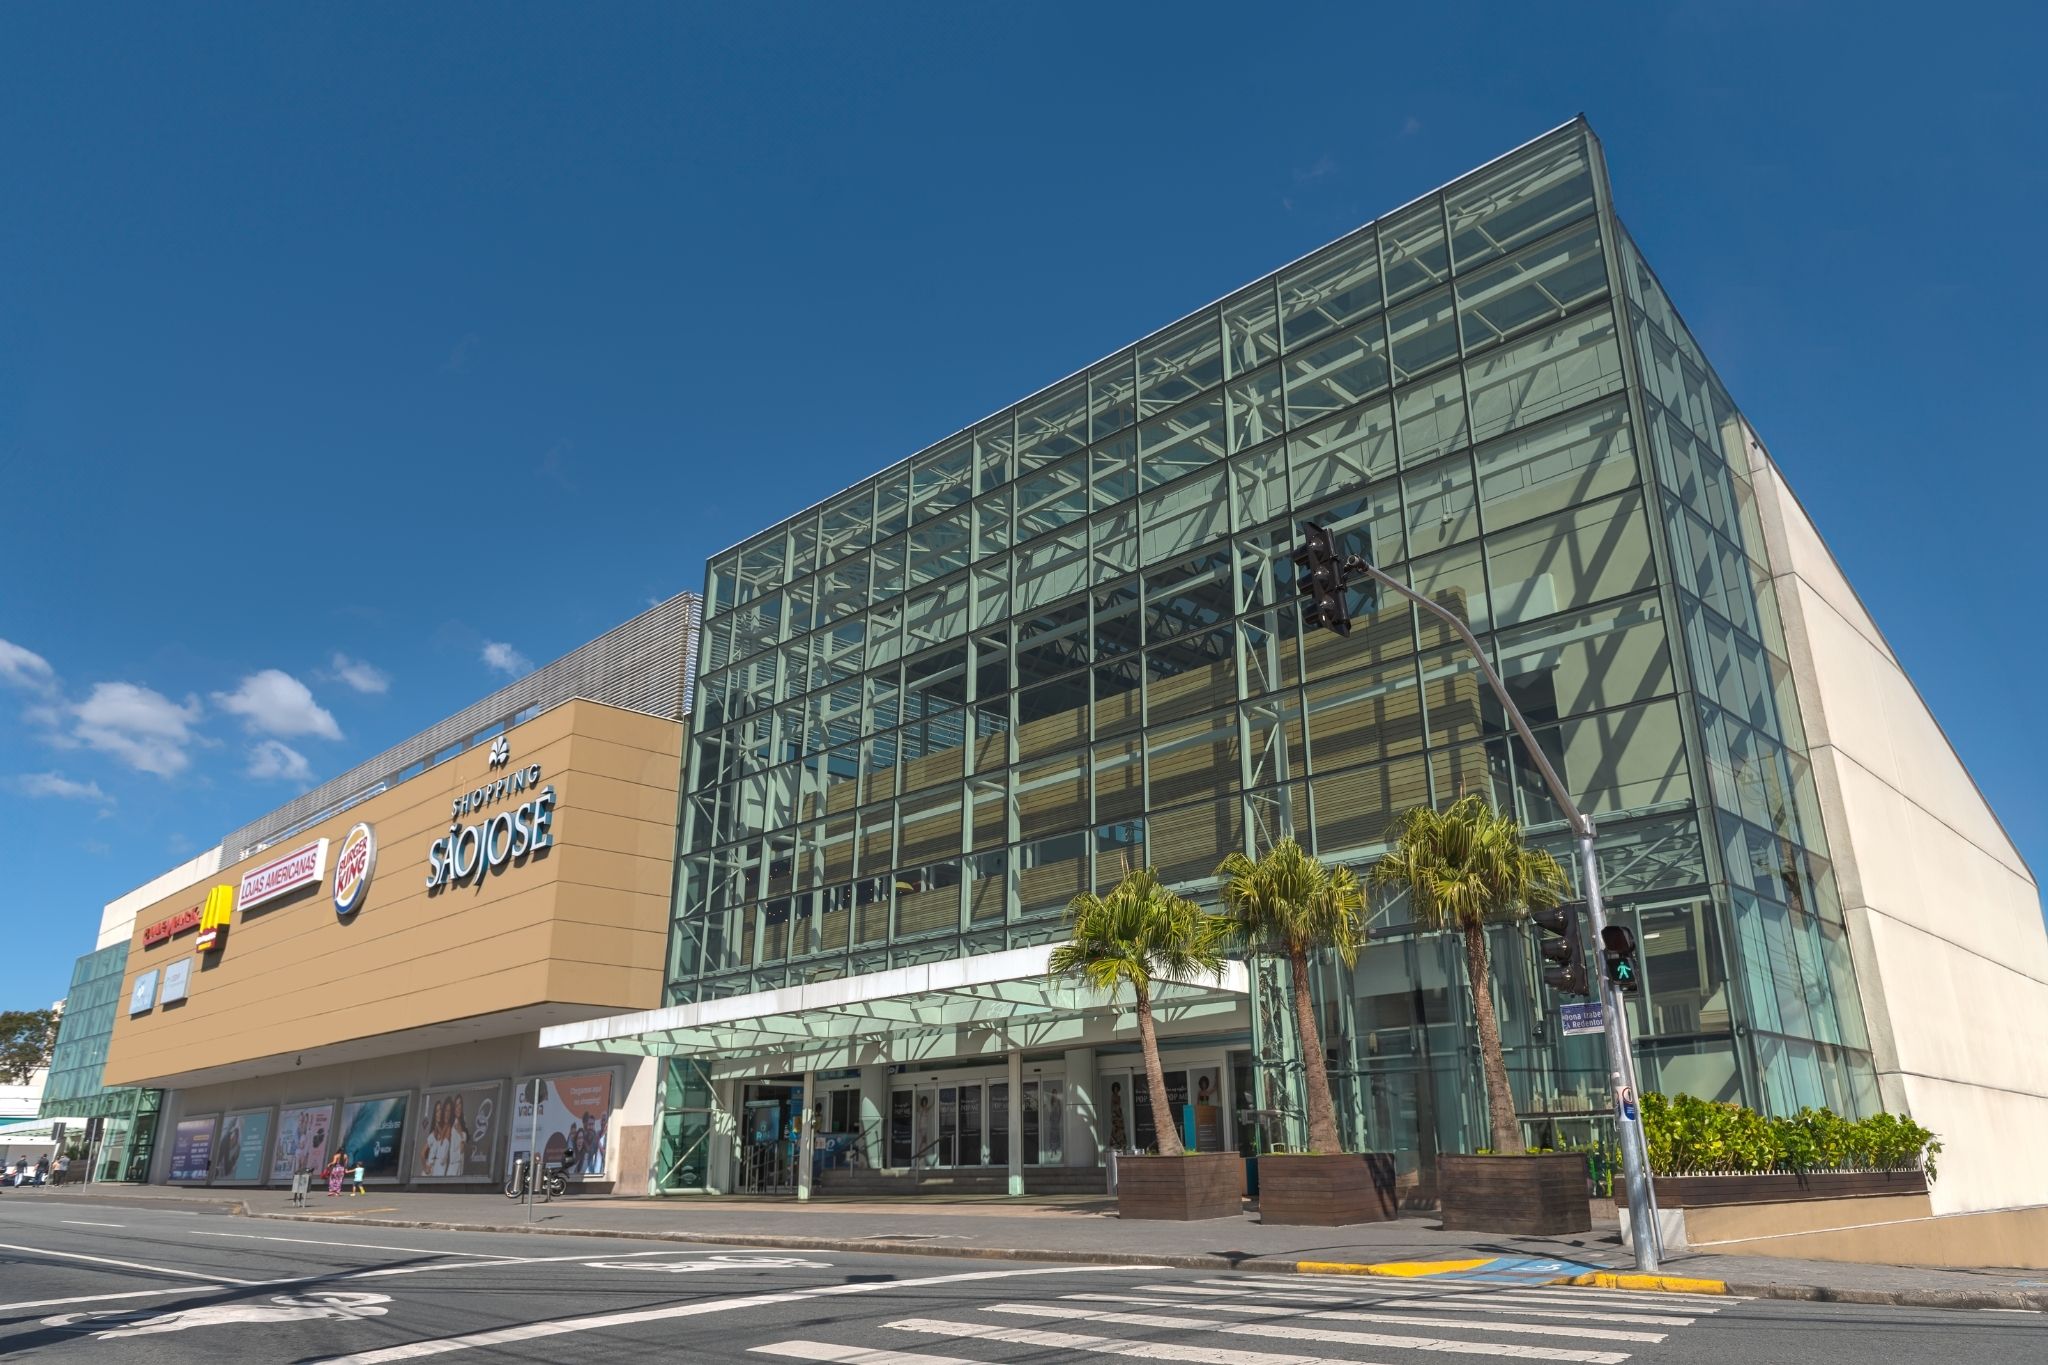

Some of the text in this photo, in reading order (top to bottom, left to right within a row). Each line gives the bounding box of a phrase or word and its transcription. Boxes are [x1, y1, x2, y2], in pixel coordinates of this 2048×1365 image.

[452, 764, 540, 816] SHOPPING
[241, 853, 317, 900] LOJAS AMERICANAS
[336, 851, 367, 898] KING
[339, 836, 368, 875] BURGER
